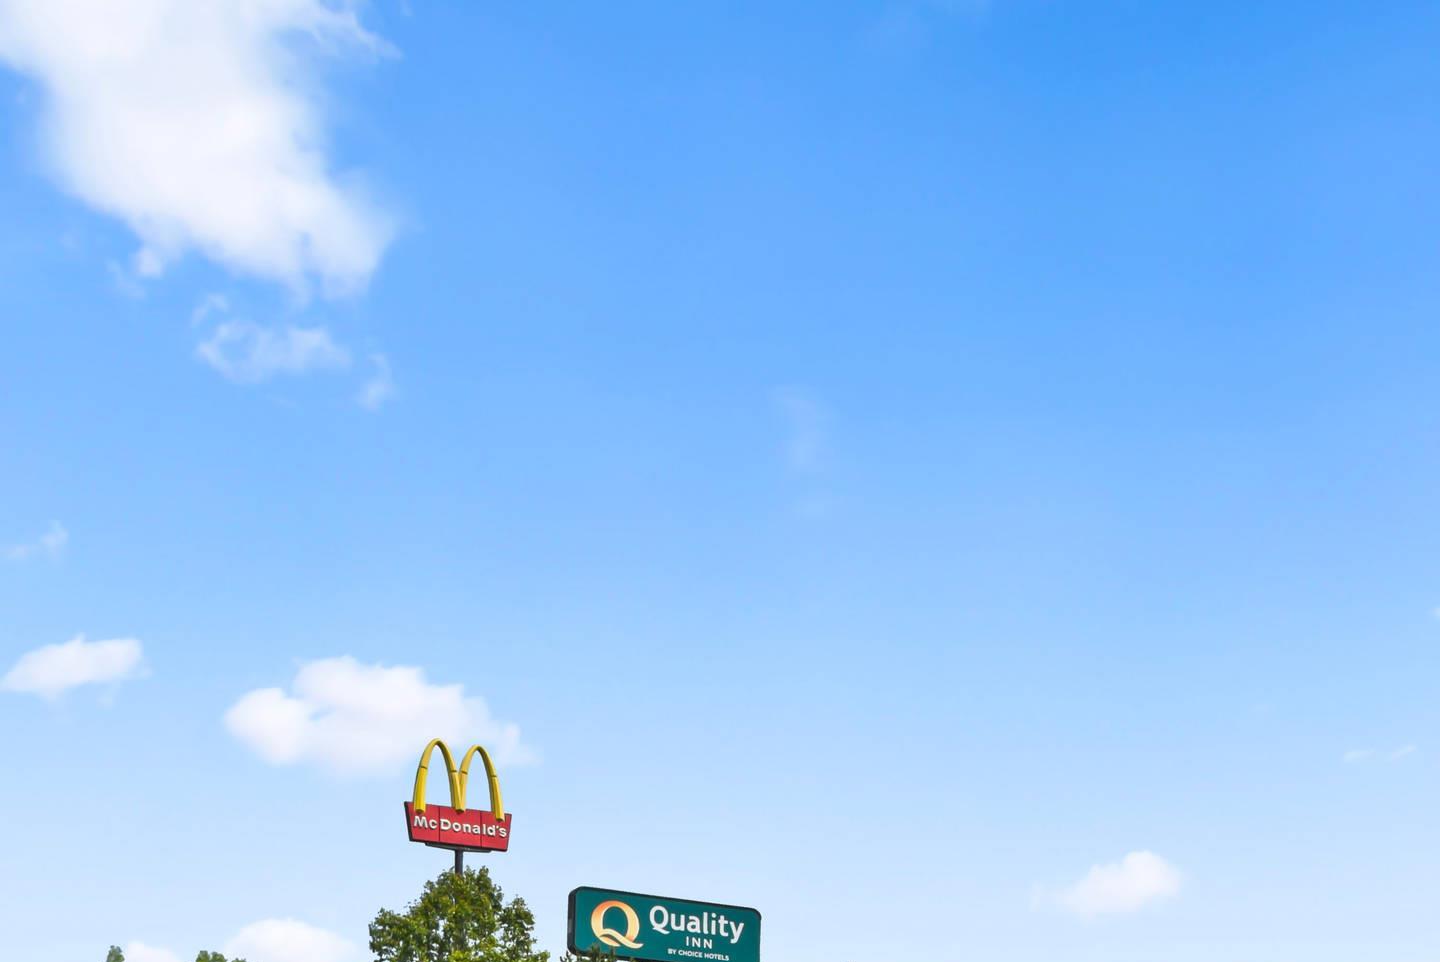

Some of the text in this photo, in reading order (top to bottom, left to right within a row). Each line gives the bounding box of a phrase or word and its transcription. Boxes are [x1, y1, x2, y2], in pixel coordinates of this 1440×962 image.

[413, 815, 508, 838] McDonald's
[590, 900, 644, 949] Q
[649, 905, 745, 944] Quality
[685, 935, 713, 949] INN
[678, 949, 703, 958] CHOICE
[704, 952, 730, 961] HOTELS
